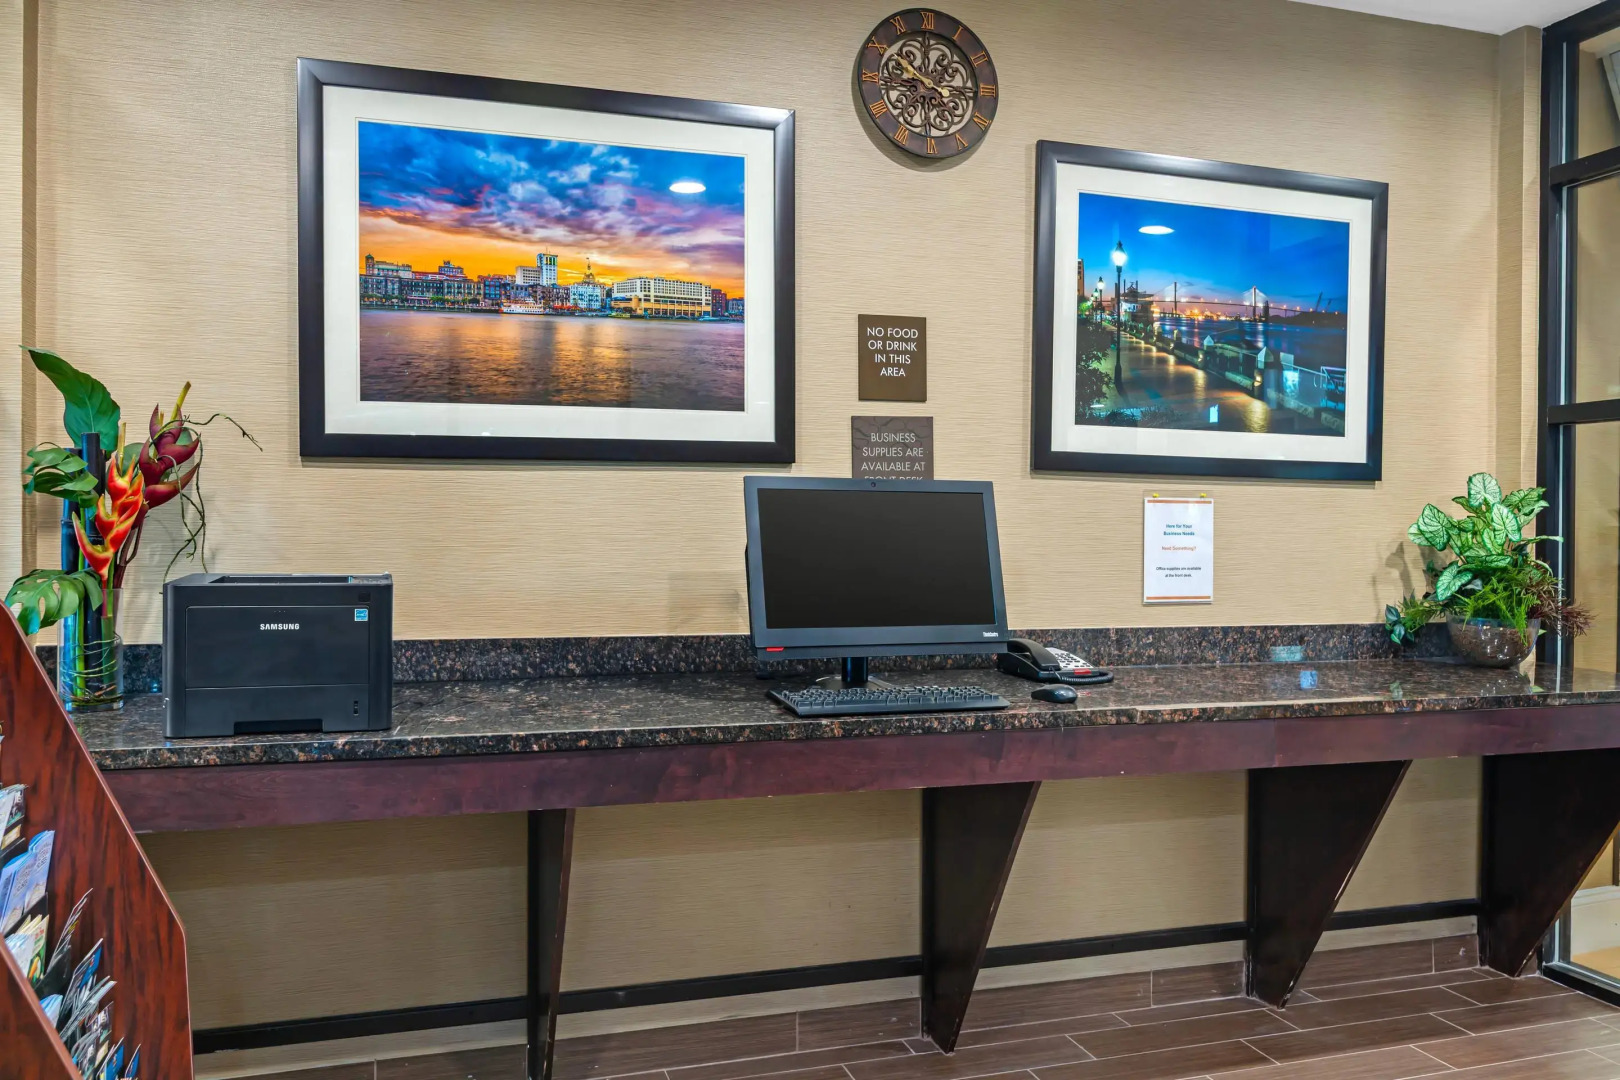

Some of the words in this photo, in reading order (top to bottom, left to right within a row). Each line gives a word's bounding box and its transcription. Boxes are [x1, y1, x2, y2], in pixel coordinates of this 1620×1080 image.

[890, 16, 906, 34] XI
[920, 12, 934, 30] XII
[952, 25, 964, 40] I
[866, 36, 888, 54] X
[970, 51, 988, 68] II
[862, 69, 879, 84] IX
[980, 83, 996, 97] III
[869, 99, 888, 119] VIII
[972, 112, 992, 130] IV
[894, 124, 909, 146] VII
[955, 134, 968, 150] V
[926, 138, 938, 154] VI
[867, 327, 884, 337] NO
[888, 328, 918, 338] FOOD
[868, 340, 883, 350] OR
[886, 341, 917, 351] DRINK
[875, 354, 886, 363] IN
[889, 354, 911, 364] THIS
[880, 367, 906, 377] AREA
[870, 432, 916, 442] BUSINESS
[862, 447, 903, 457] SUPPLIES
[905, 448, 924, 457] ARE
[861, 462, 910, 471] AVAILABLE
[913, 462, 926, 471] AT
